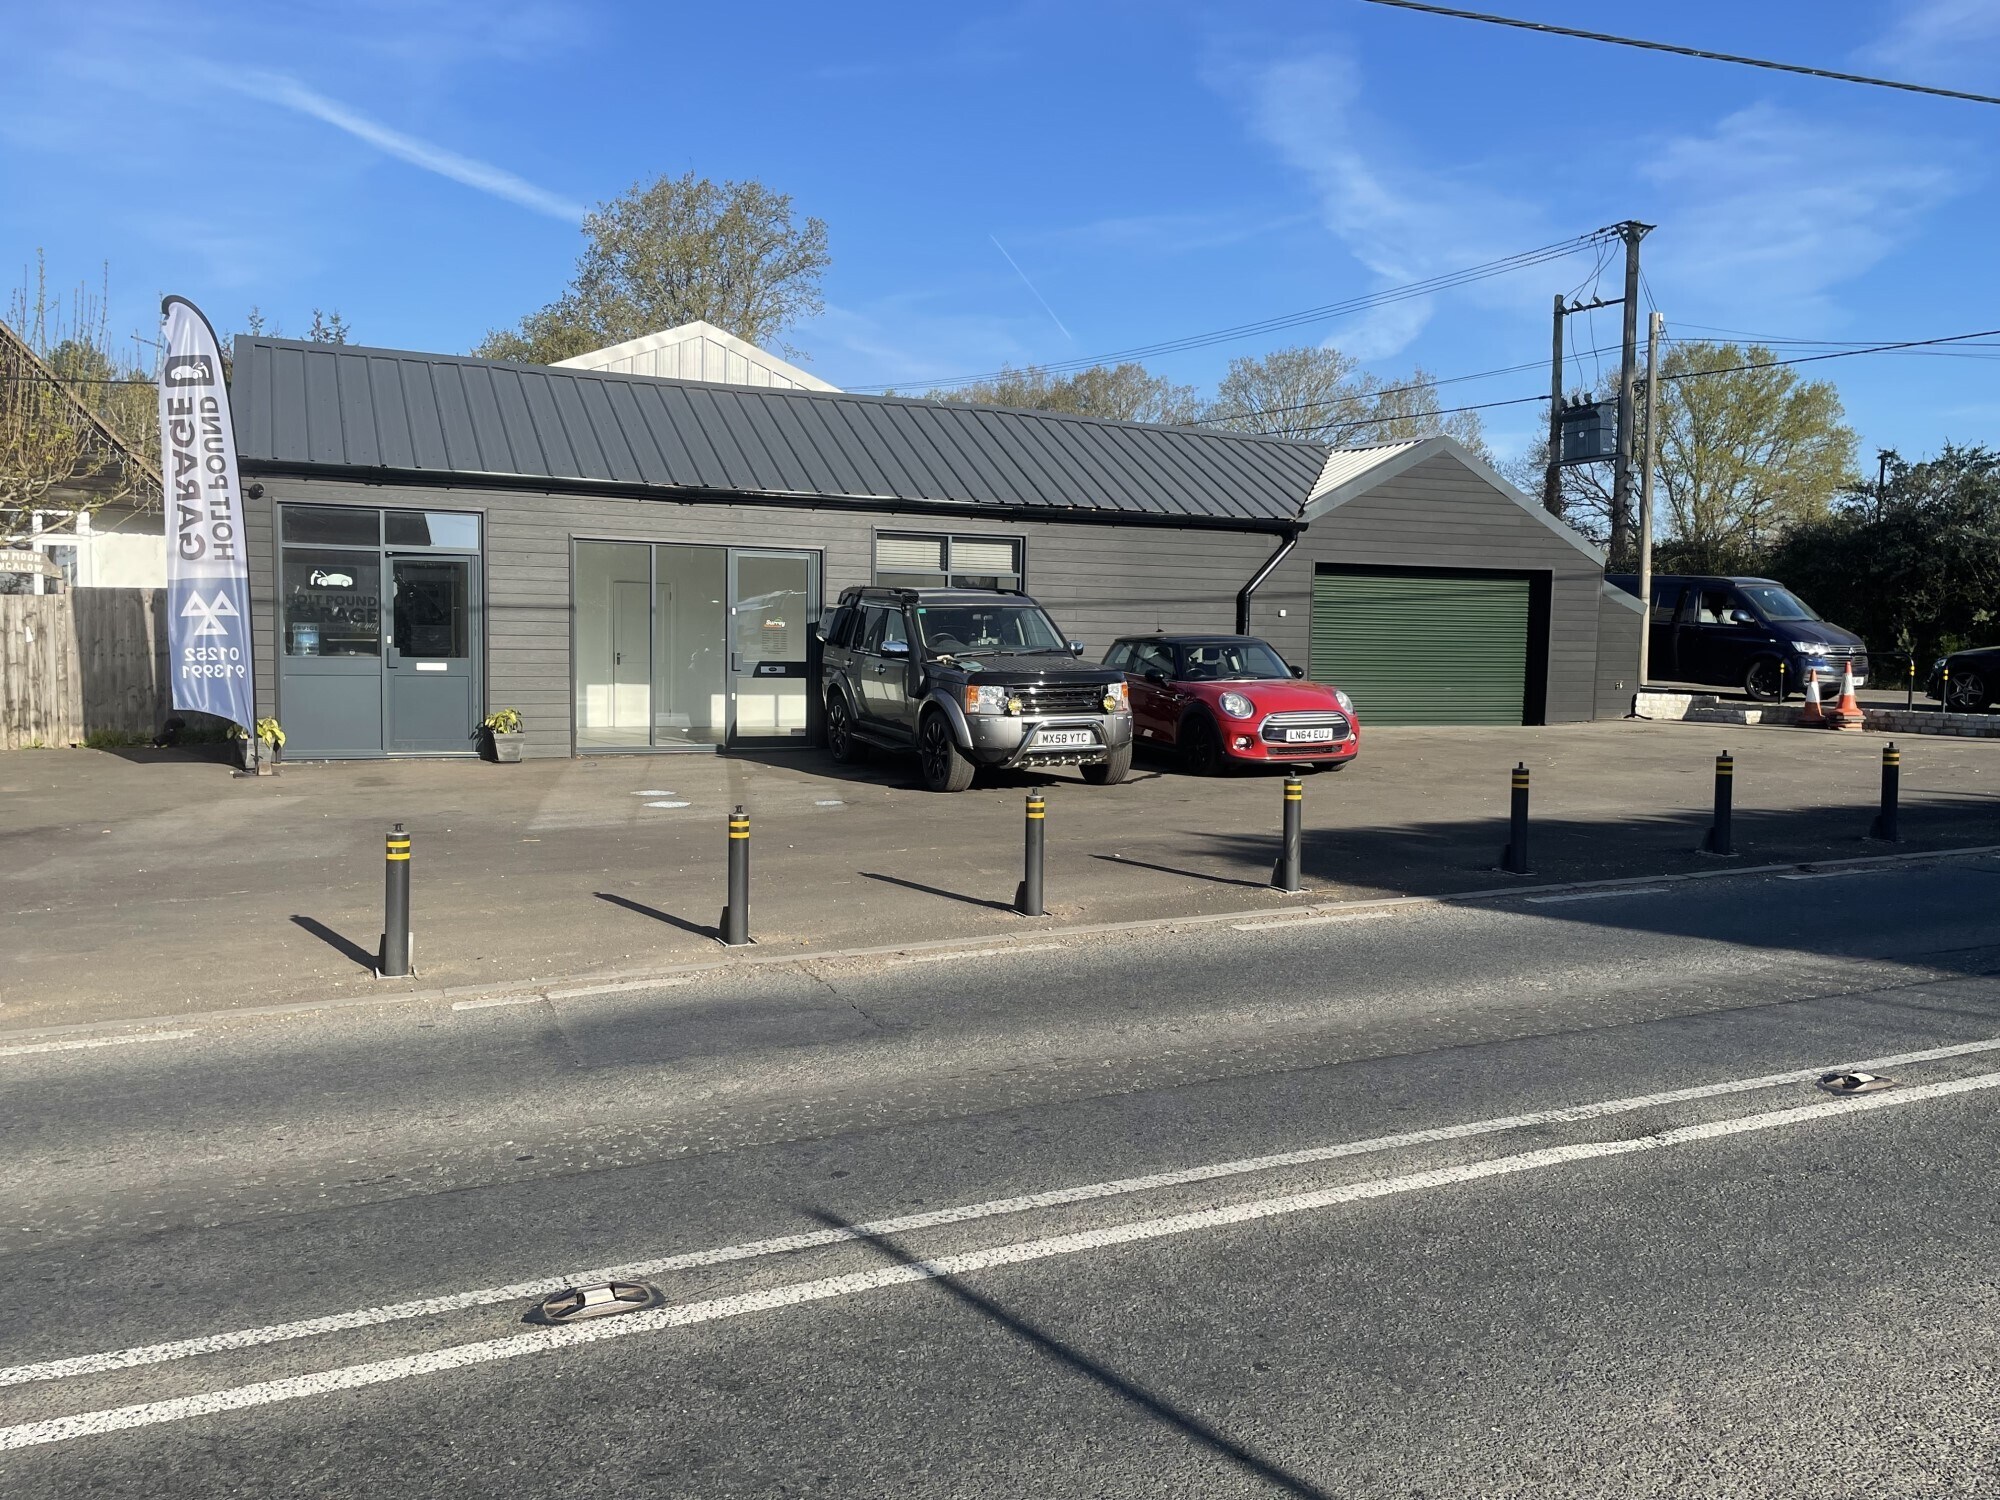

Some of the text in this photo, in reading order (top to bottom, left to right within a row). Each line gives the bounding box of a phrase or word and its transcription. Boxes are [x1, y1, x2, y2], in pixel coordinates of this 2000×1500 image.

[12, 552, 41, 562] MOON
[0, 562, 44, 572] NGALOW
[325, 594, 377, 606] POUND
[288, 606, 378, 623] RAGE
[1042, 733, 1087, 743] MX58 YTC
[1290, 730, 1330, 740] LN64 EUJ
